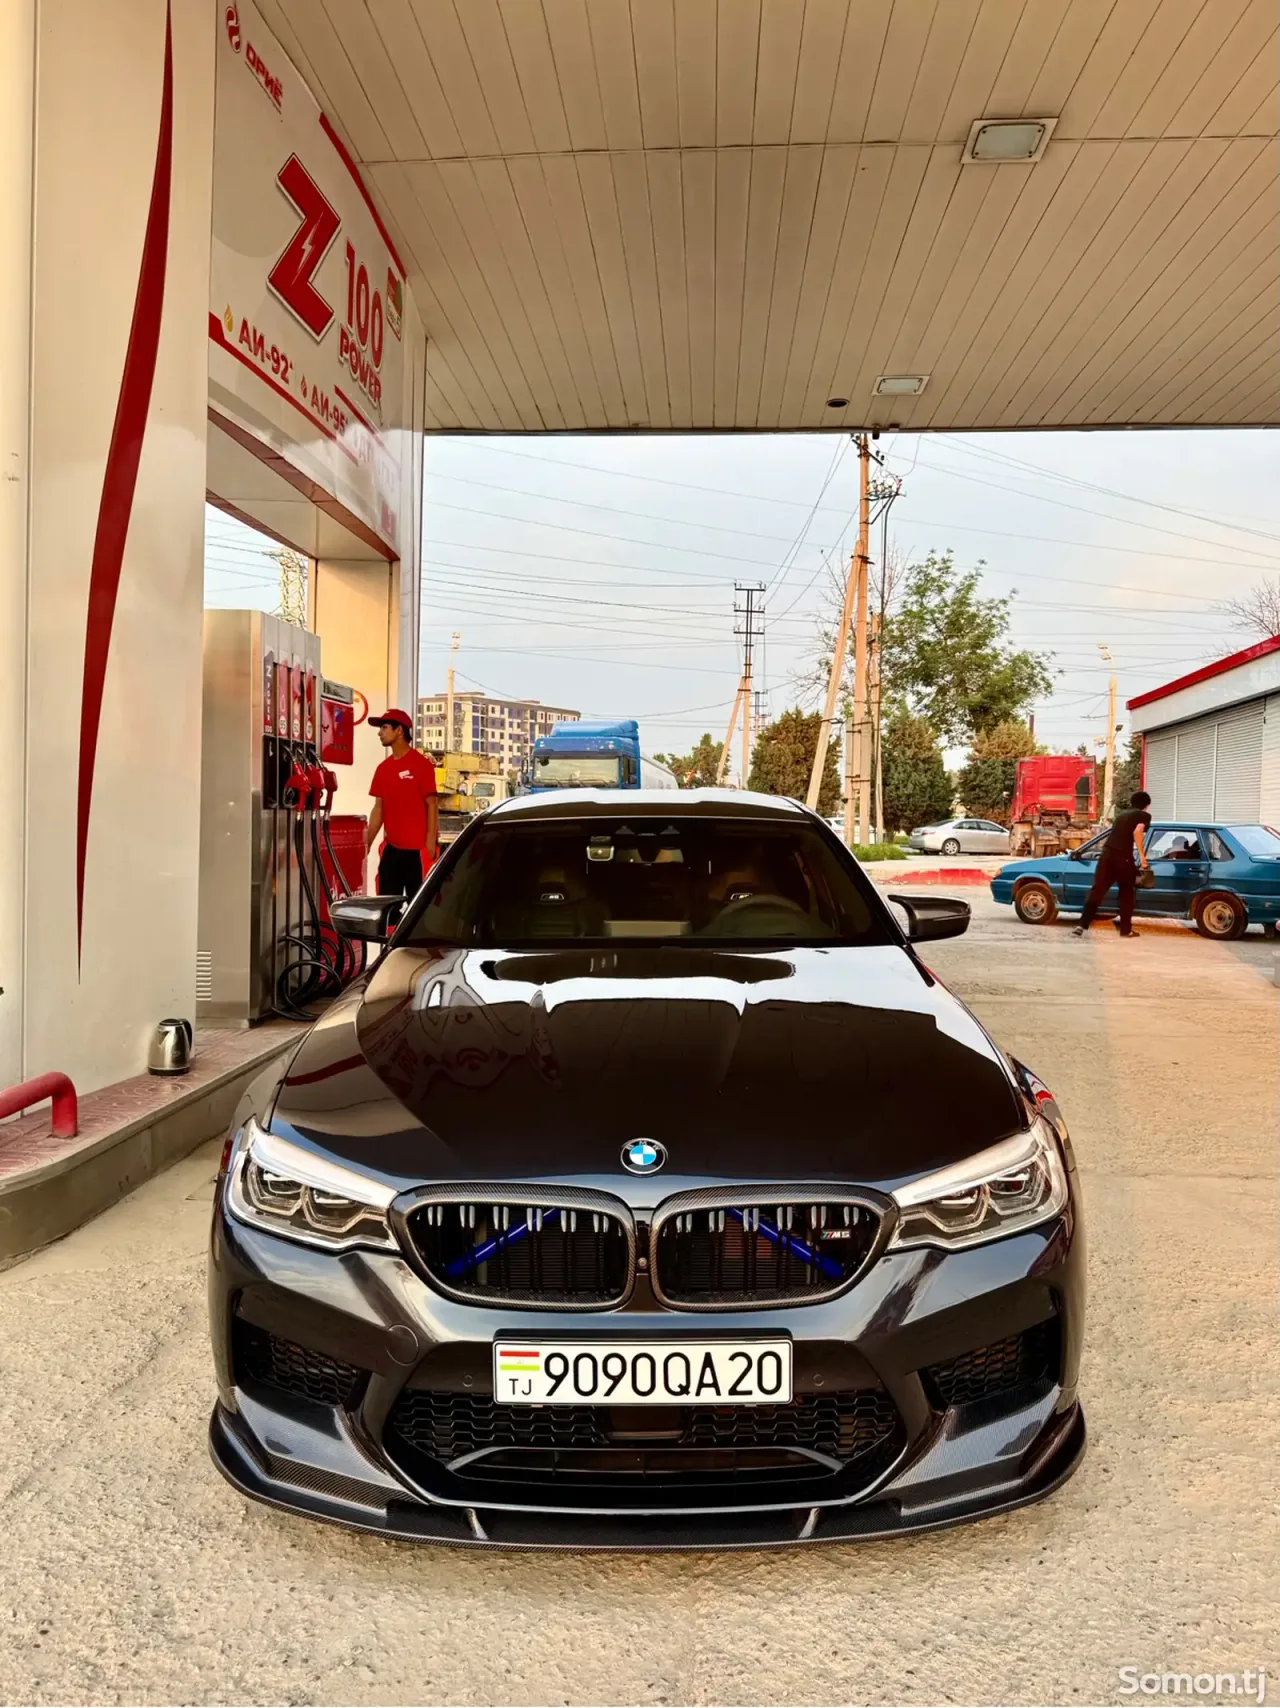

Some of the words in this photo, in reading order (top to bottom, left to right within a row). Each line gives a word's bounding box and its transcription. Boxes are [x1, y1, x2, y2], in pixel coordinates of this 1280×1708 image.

[346, 238, 383, 369] 100
[340, 325, 381, 403] POWER
[508, 1378, 532, 1396] TJ
[544, 1351, 783, 1397] 9090QA20
